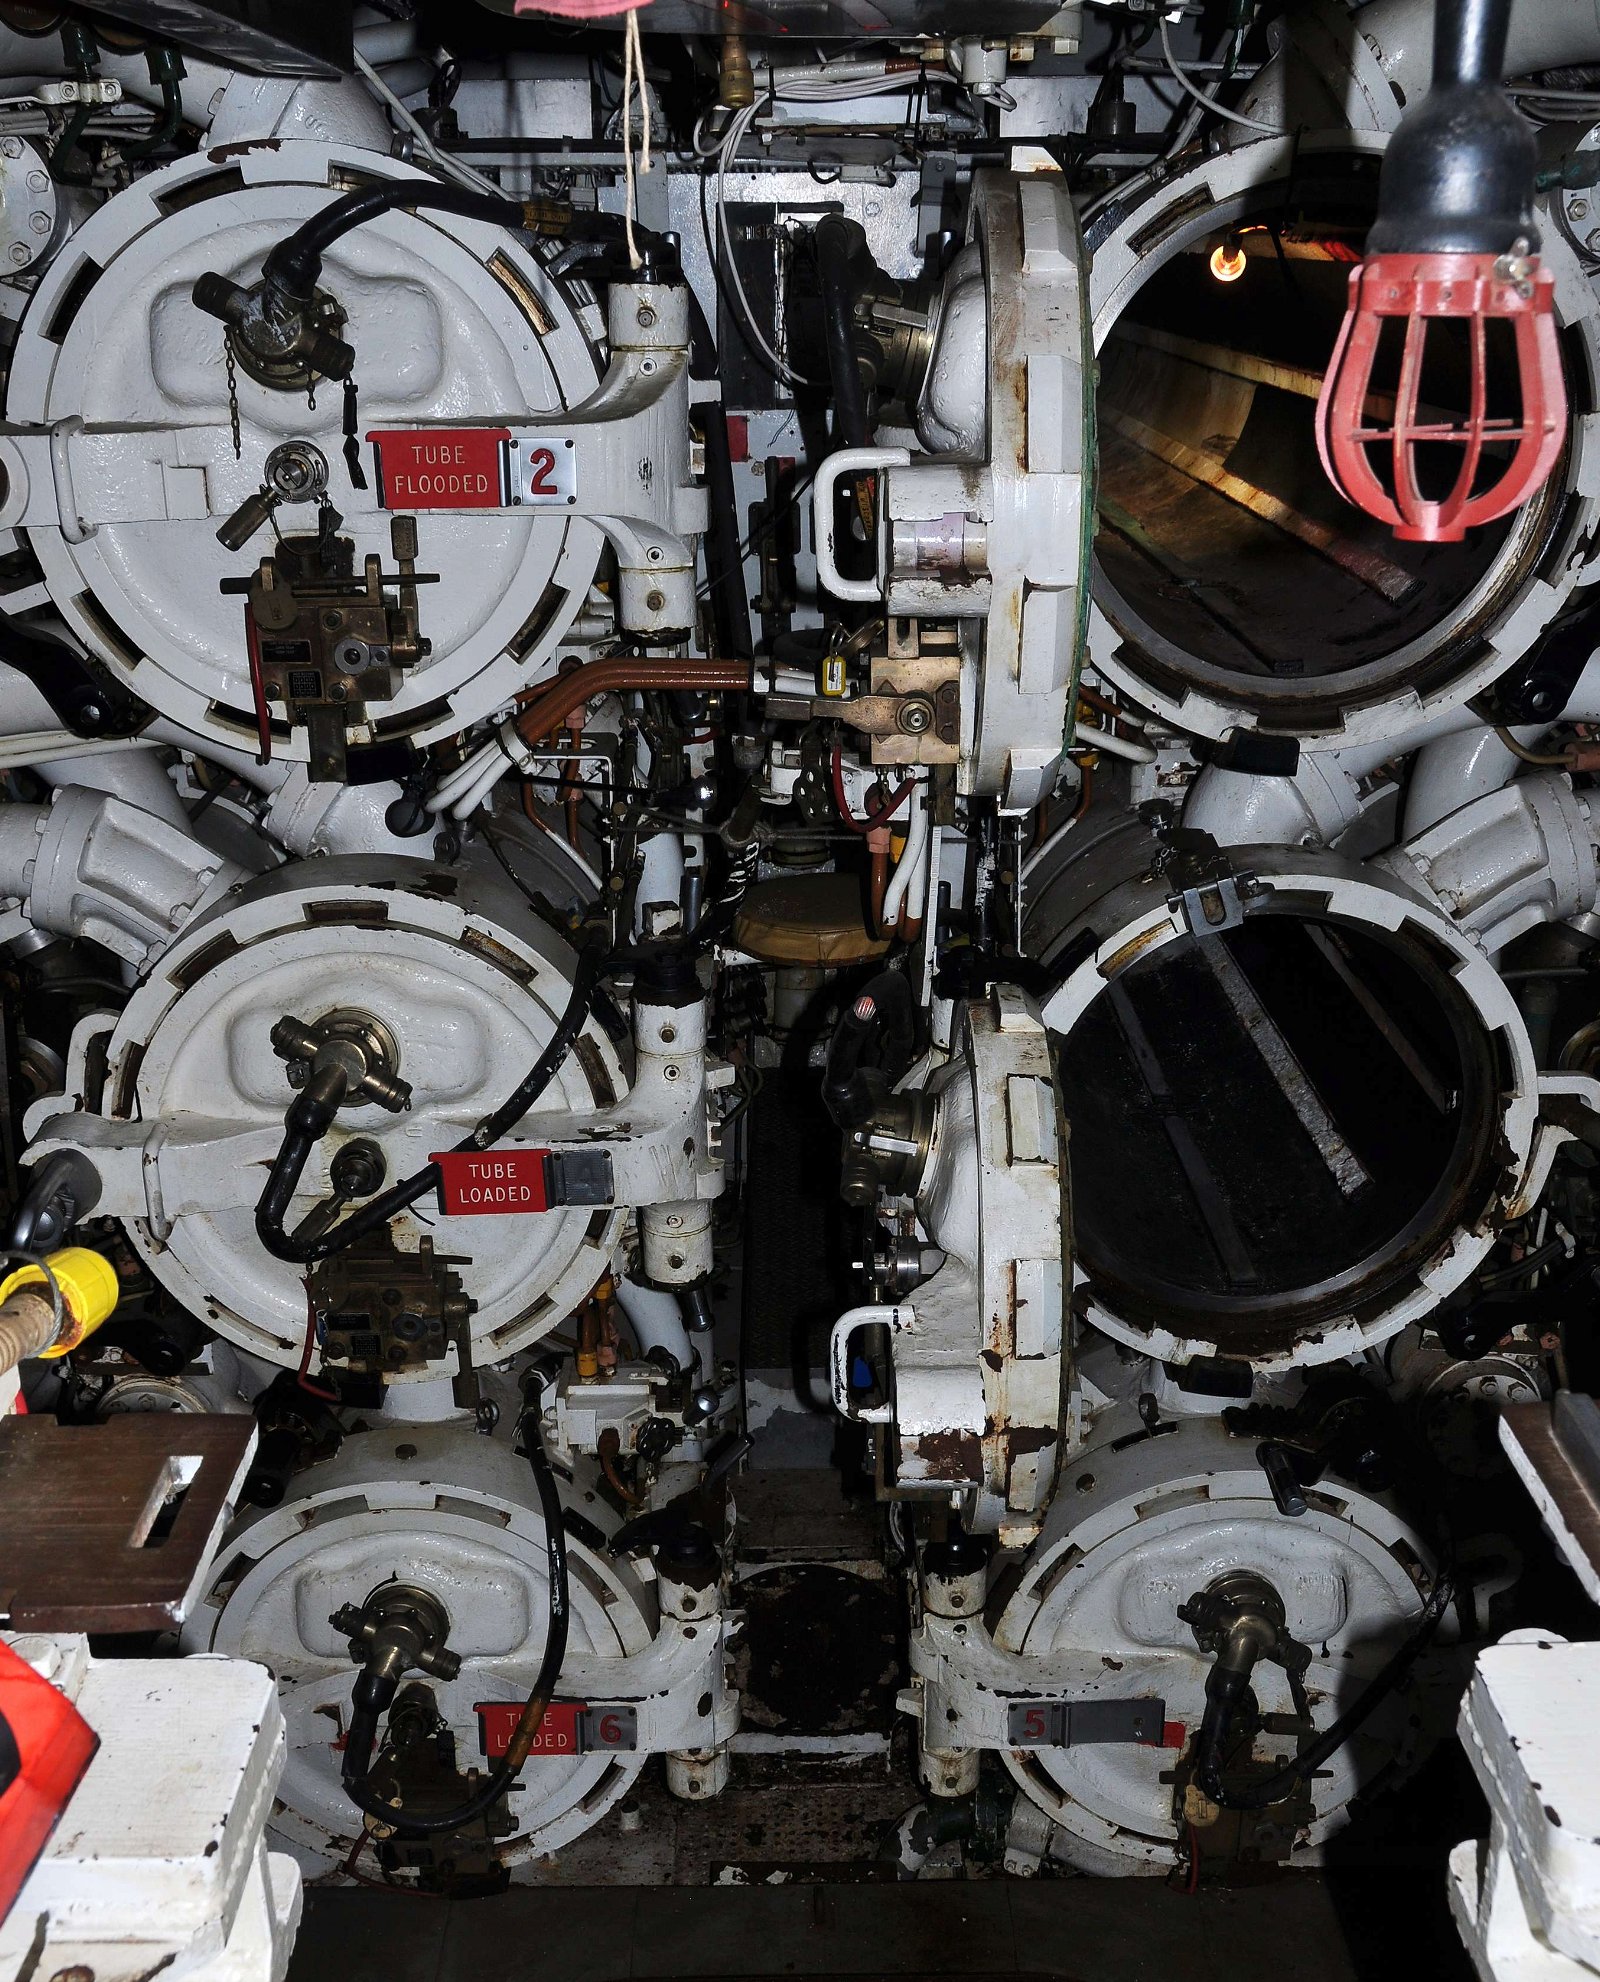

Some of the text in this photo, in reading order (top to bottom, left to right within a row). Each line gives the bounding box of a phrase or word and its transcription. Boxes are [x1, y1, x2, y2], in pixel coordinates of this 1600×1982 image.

[411, 445, 466, 464] TUBE
[530, 447, 558, 495] 2
[394, 474, 489, 494] FLOODED
[468, 1163, 517, 1179] TUBE
[459, 1186, 531, 1204] LOADED
[506, 1713, 553, 1727] TE
[599, 1714, 622, 1744] 6
[1023, 1709, 1046, 1739] 5
[497, 1733, 568, 1748] LDED
